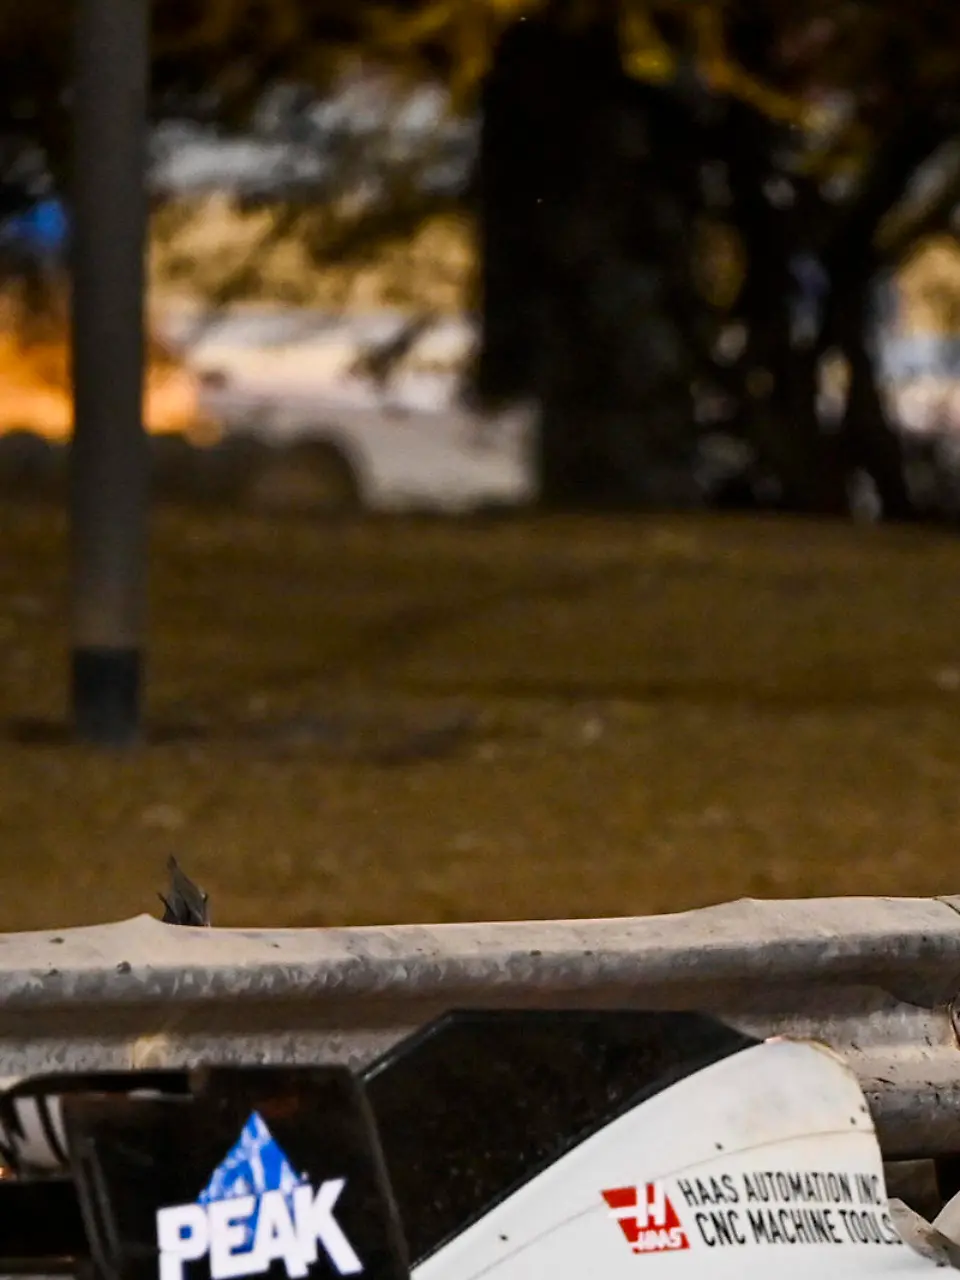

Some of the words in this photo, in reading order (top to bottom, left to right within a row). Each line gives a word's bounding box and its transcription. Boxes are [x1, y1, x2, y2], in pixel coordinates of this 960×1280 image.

[678, 1174, 738, 1206] HAAS
[741, 1171, 853, 1204] AUTOMATION
[696, 1208, 746, 1247] CNC
[749, 1207, 840, 1245] MACHINE
[838, 1208, 903, 1245] TOOLS
